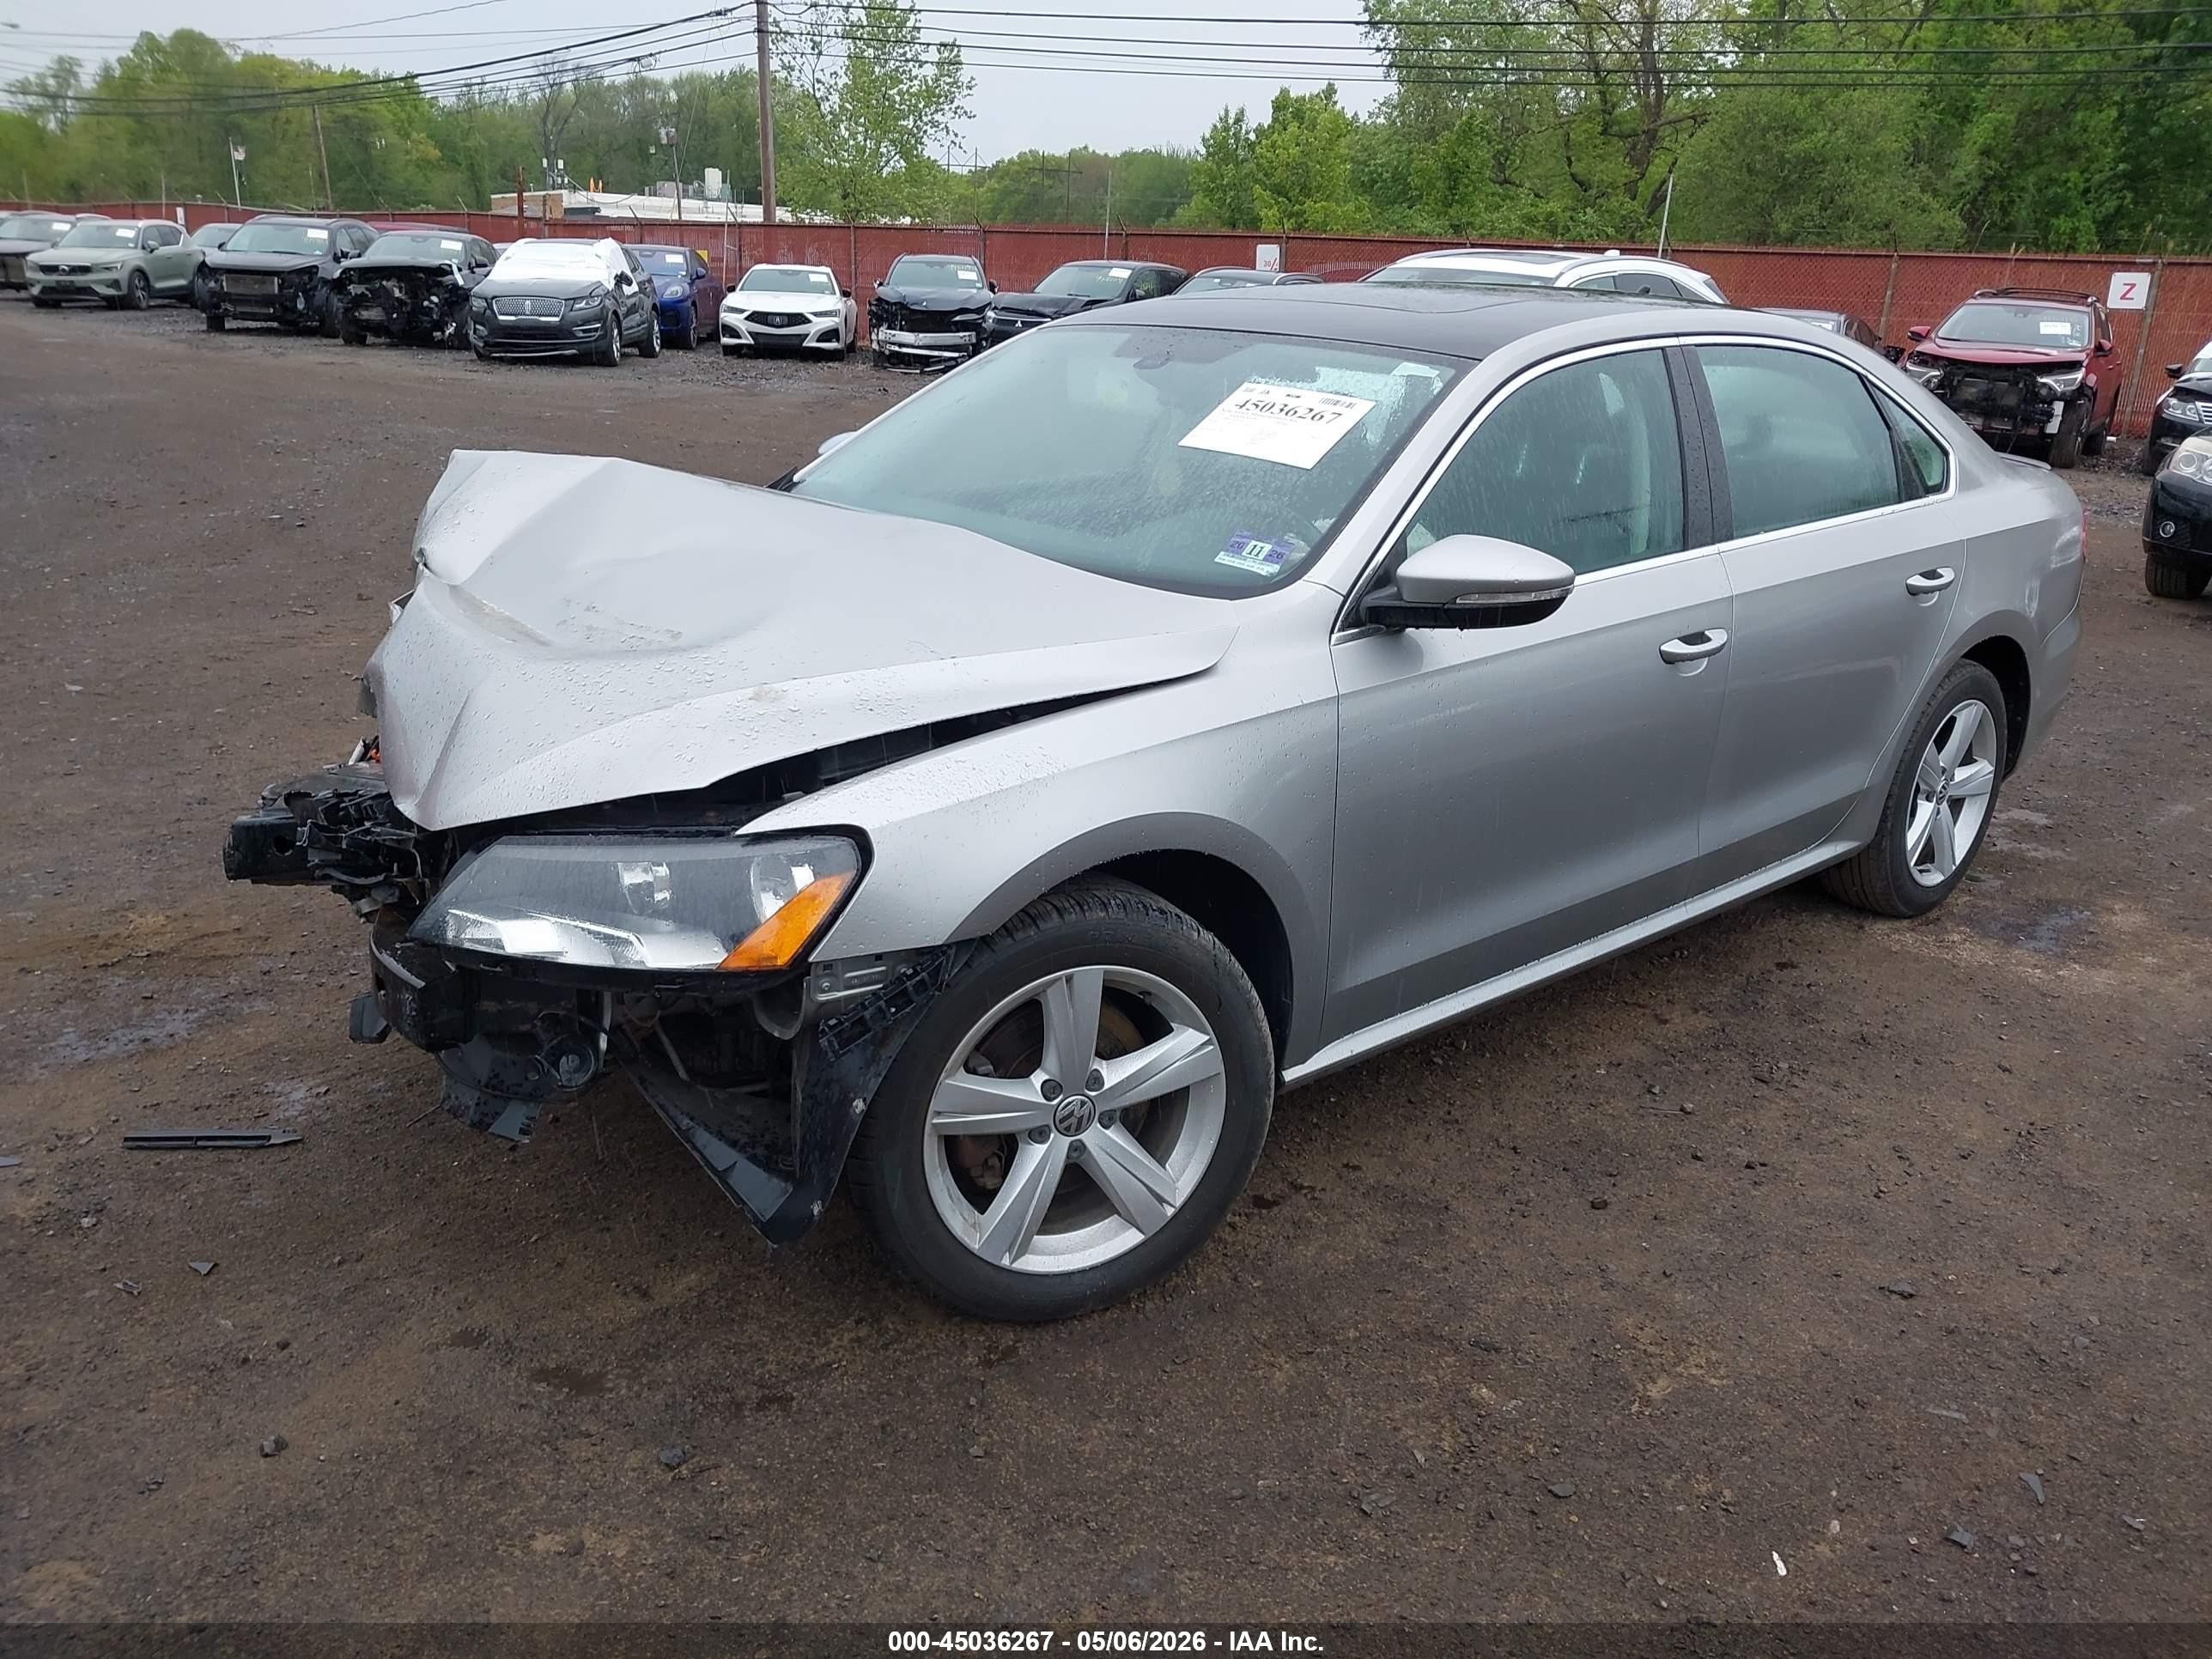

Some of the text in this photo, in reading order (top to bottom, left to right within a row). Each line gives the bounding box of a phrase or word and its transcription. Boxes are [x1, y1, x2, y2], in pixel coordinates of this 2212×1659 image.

[2119, 283, 2137, 301] Z
[1234, 398, 1343, 425] 45036267
[1246, 544, 1264, 557] 11
[1267, 550, 1285, 560] 26
